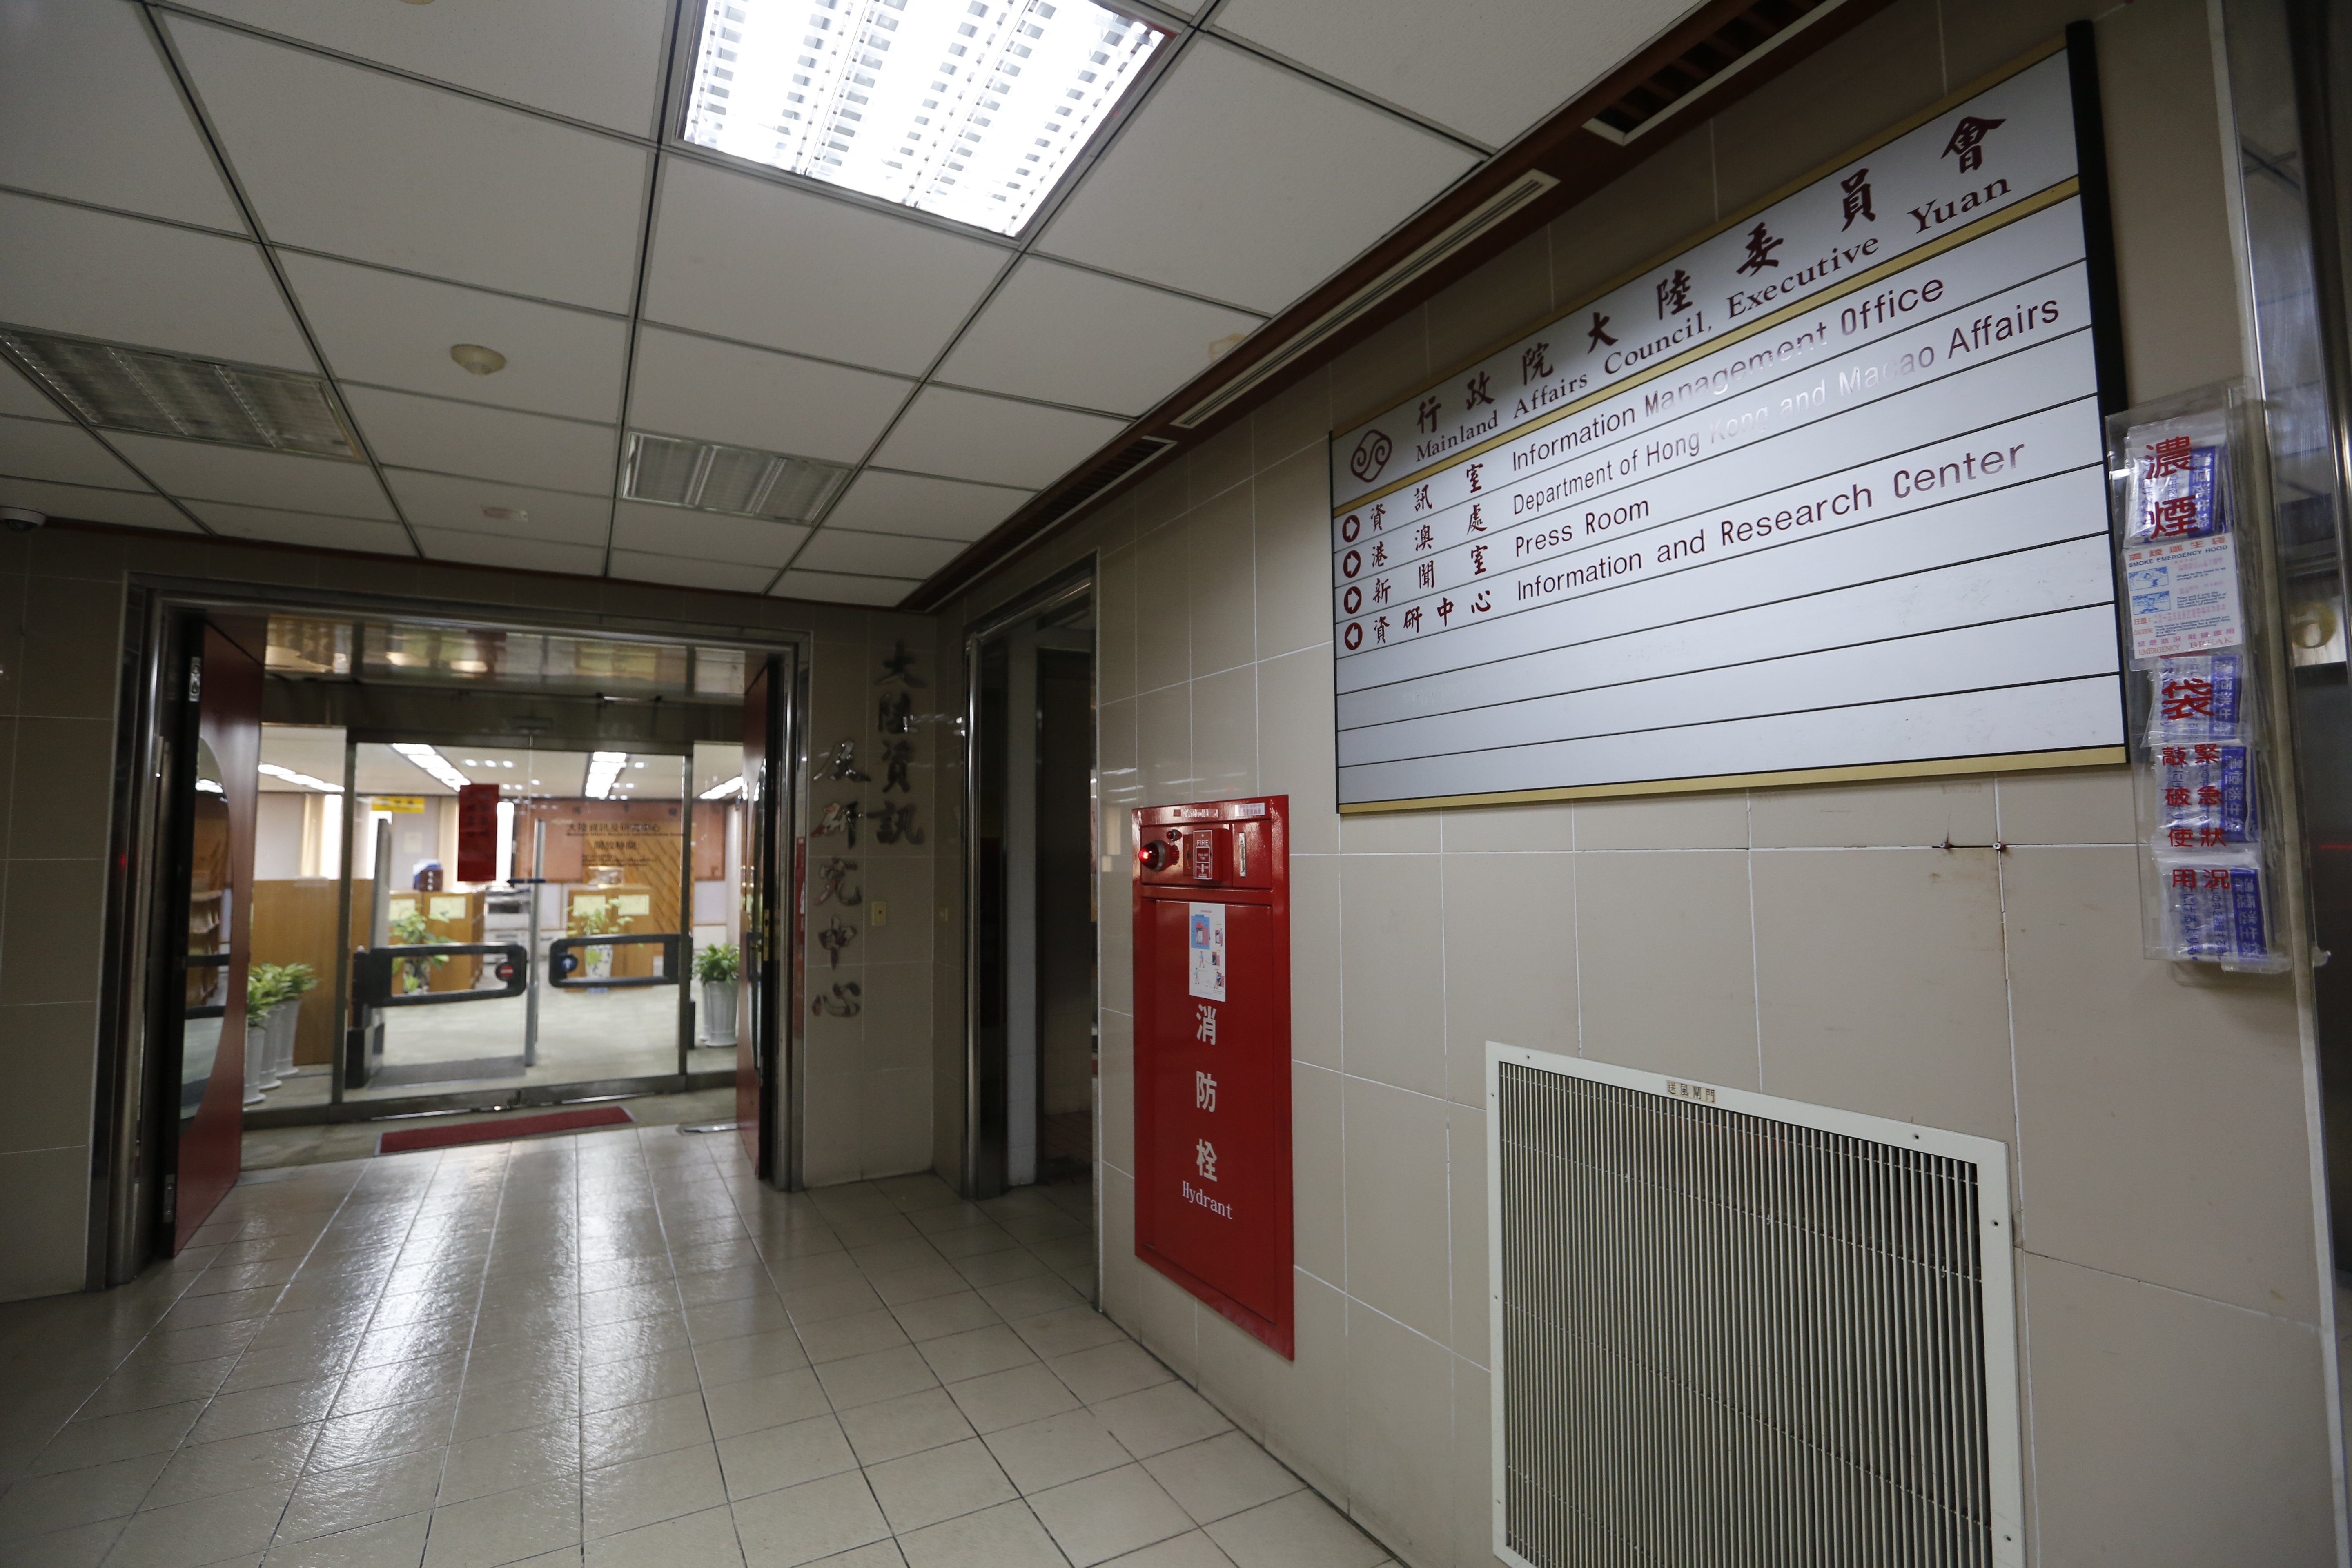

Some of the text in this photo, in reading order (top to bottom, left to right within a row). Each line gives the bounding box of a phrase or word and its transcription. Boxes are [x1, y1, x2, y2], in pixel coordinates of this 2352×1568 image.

[1417, 116, 2007, 434] 行政院大陸委員會
[1416, 178, 2011, 462] Mainland Affairs Council, Executive Yuan
[1513, 278, 1944, 471] Information Management Office
[1514, 299, 2058, 514] Department of Hong Kong and Macao Affairs
[1371, 463, 1483, 532] 資訊室
[1516, 500, 1650, 557] Press Room
[1518, 443, 2024, 600] Information and Research Center
[1372, 503, 1488, 568] 港澳處
[2129, 559, 2153, 567] SMOKE
[2157, 550, 2201, 562] EMERGENCY
[1372, 545, 1488, 604] 新聞室
[2139, 637, 2233, 655] EMERGENCY BREAK
[1196, 1004, 1218, 1183] 消防栓
[1668, 1082, 1715, 1102] 送風閘門
[1182, 1181, 1233, 1220] Hydrant
